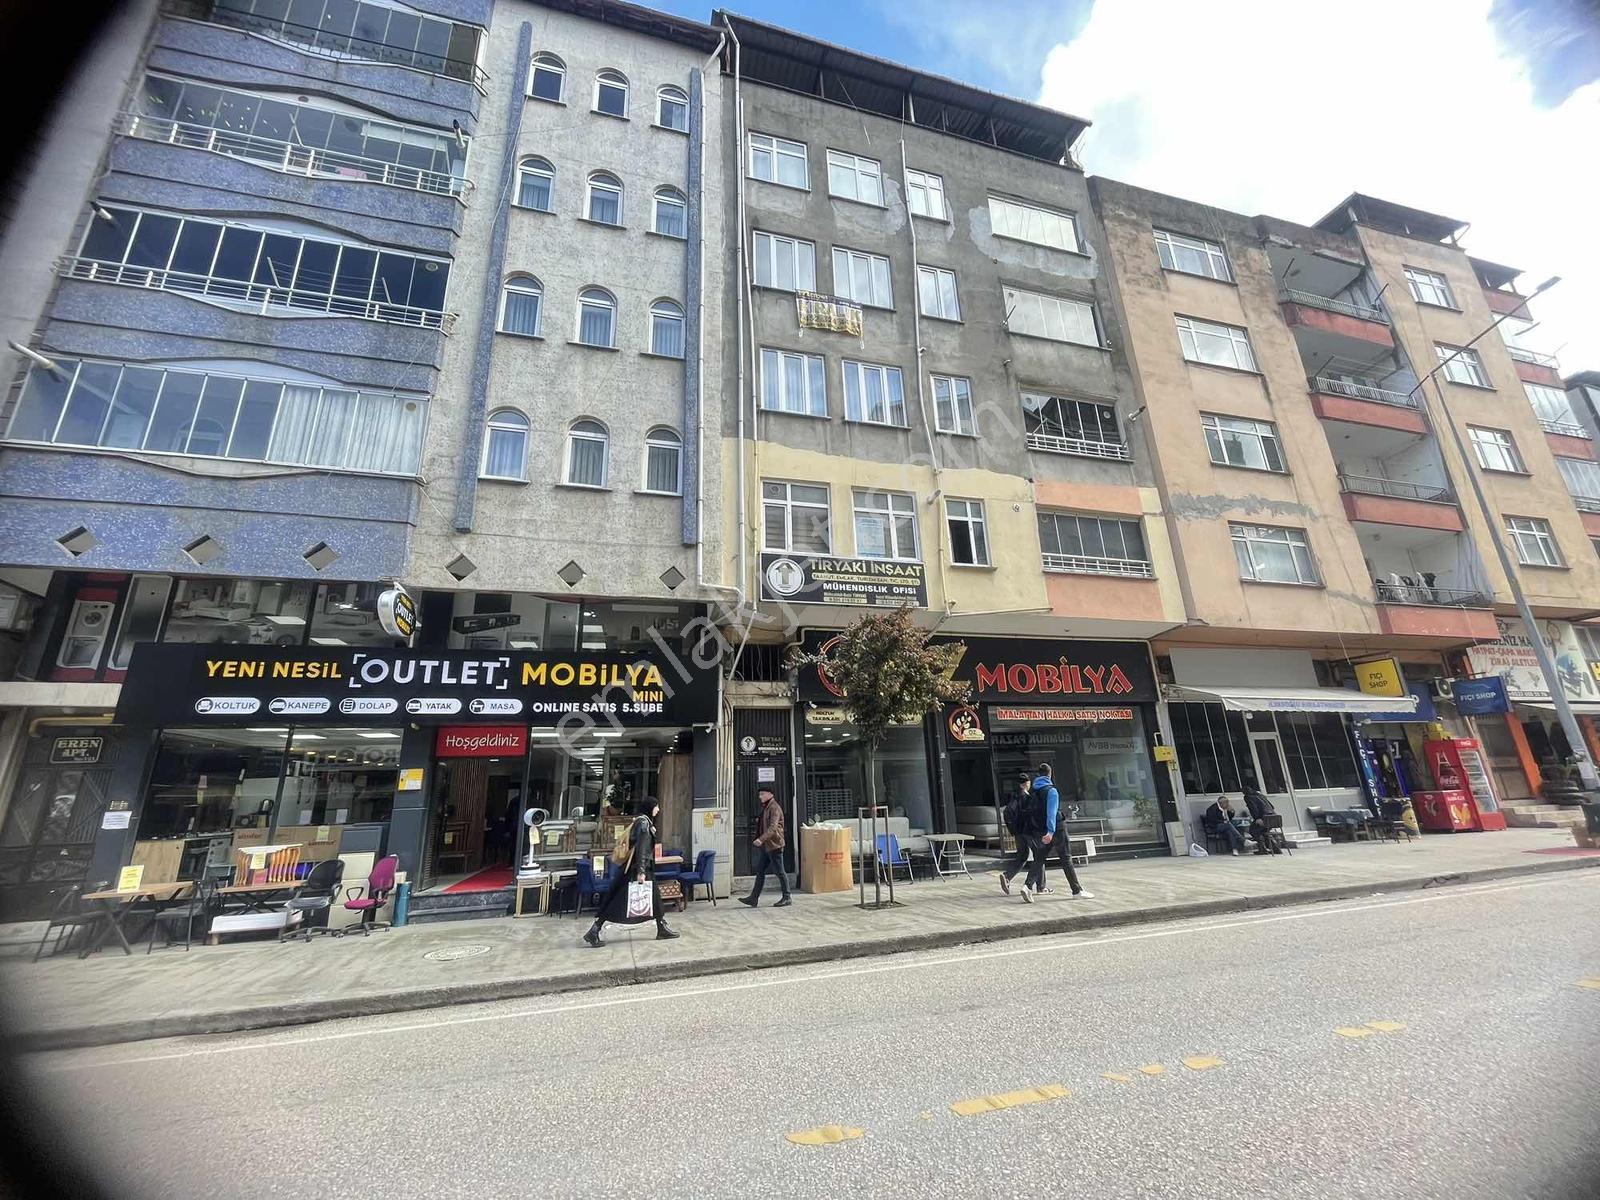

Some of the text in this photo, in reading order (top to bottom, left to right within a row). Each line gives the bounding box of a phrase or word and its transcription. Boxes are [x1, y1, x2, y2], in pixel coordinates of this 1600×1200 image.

[811, 558, 922, 577] TİRYAKİ İNŞAAT
[360, 658, 500, 685] OUTLET
[975, 656, 1134, 695] MOBİLYA
[1369, 680, 1388, 688] SHOP
[633, 690, 664, 702] MINI
[1475, 691, 1497, 700] SHOP
[214, 701, 256, 711] KOLTUK
[287, 701, 328, 711] KANEPE
[359, 702, 391, 711] DOLAP
[425, 702, 452, 710] YATAK
[490, 702, 515, 710] MASA
[532, 702, 580, 713] ONLINE
[1046, 709, 1076, 720] HALKA
[1098, 709, 1133, 720] NOKTASI
[57, 739, 100, 749] EREN
[446, 733, 520, 751] Hoşgeldiniz
